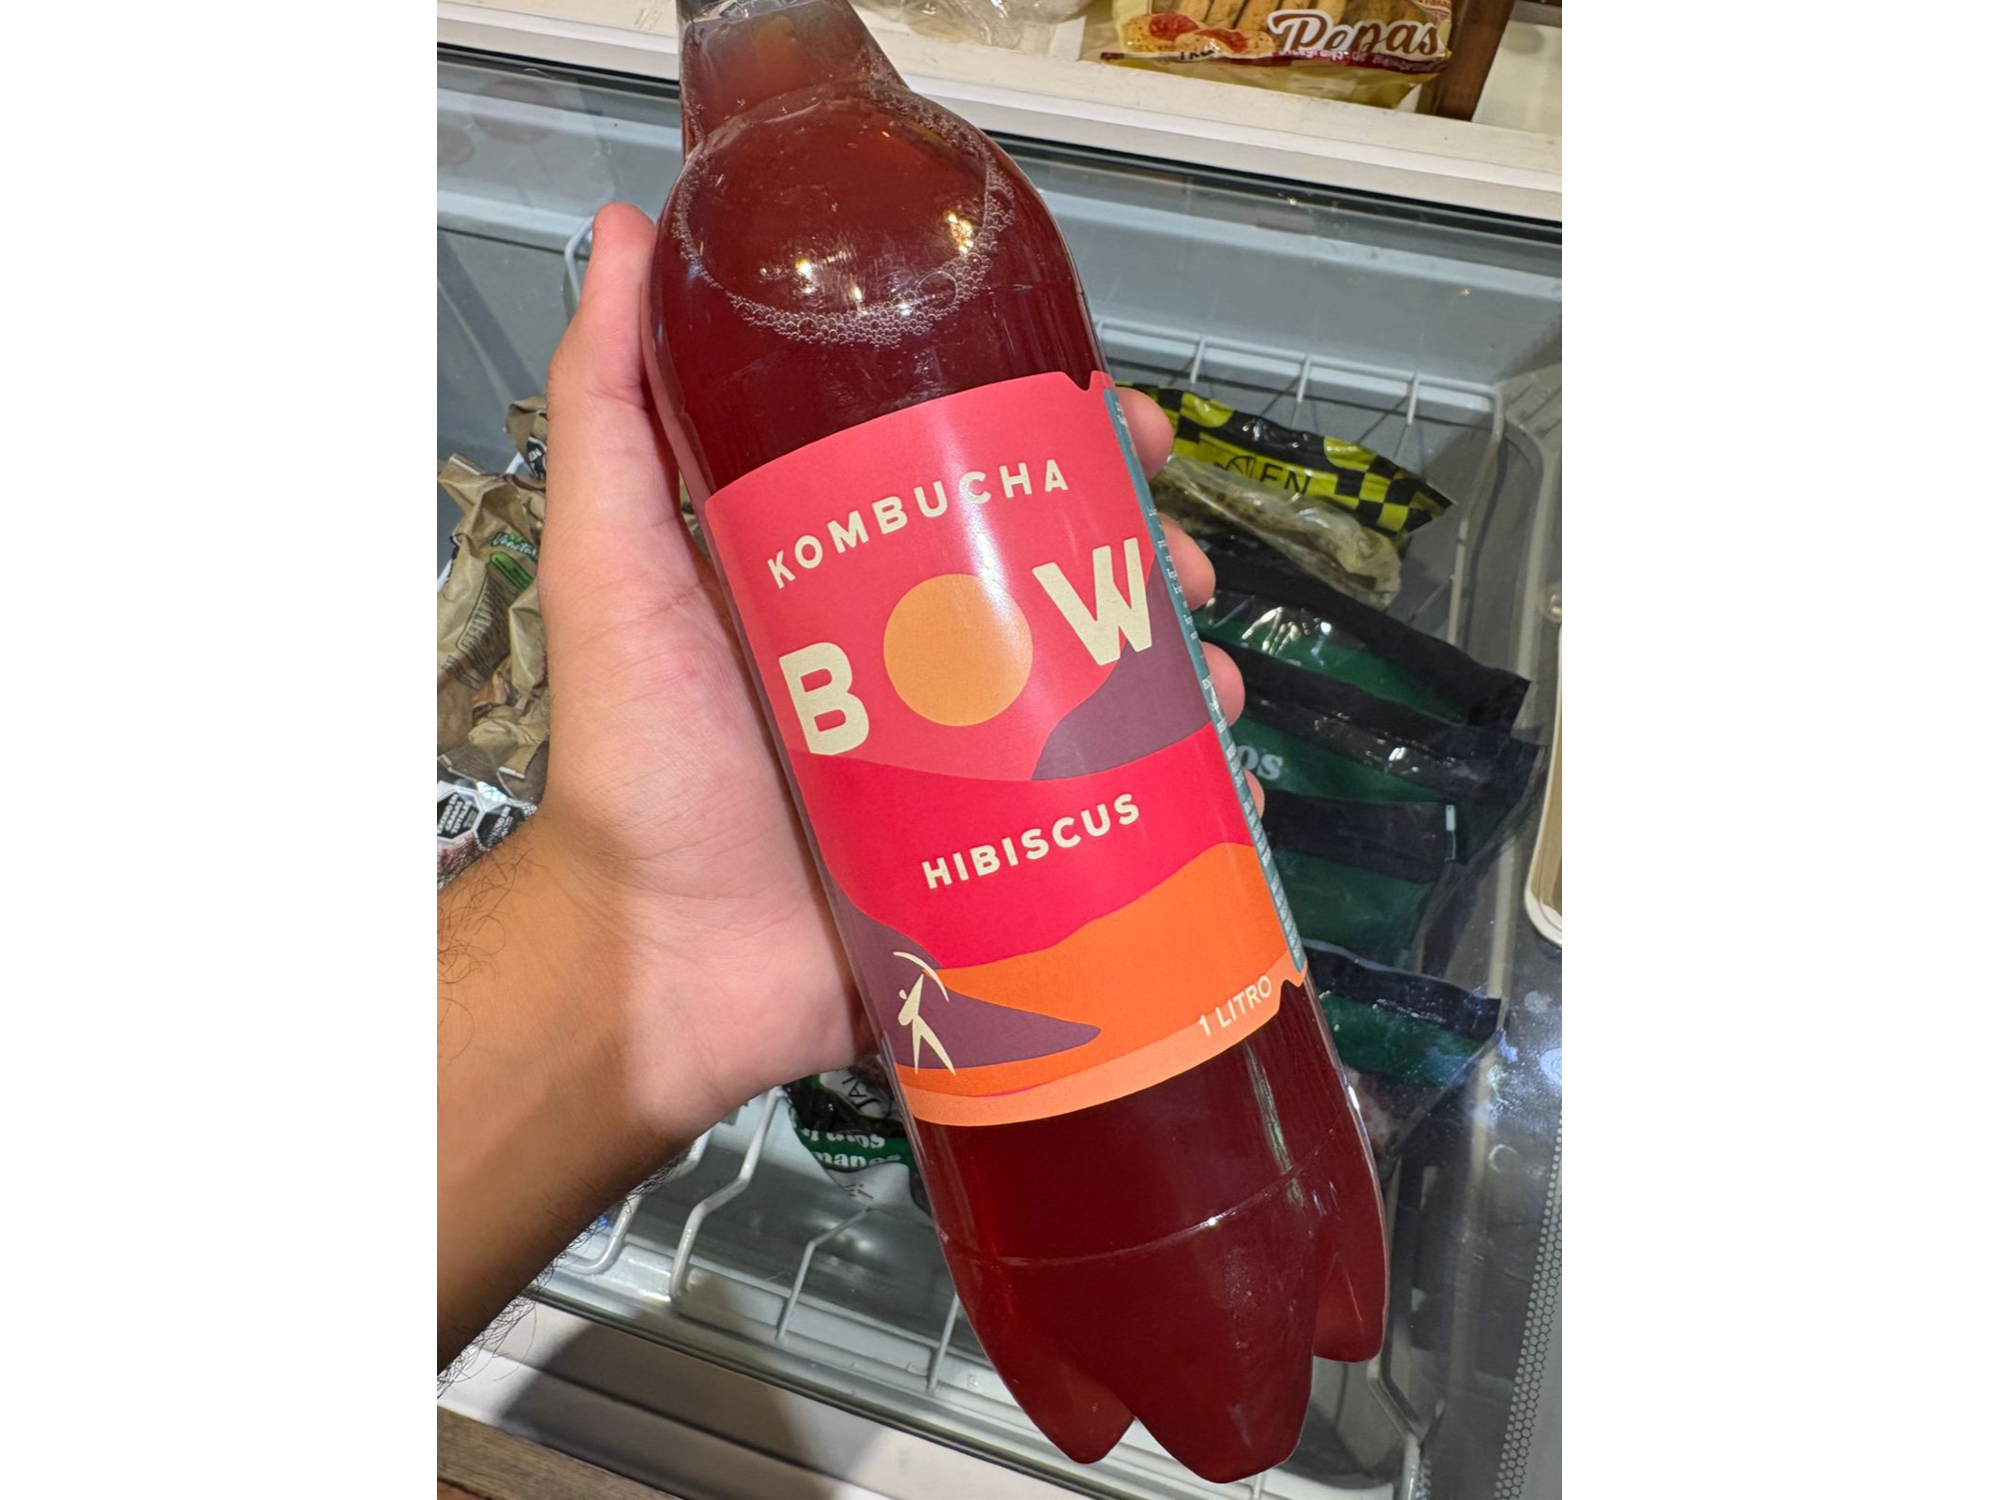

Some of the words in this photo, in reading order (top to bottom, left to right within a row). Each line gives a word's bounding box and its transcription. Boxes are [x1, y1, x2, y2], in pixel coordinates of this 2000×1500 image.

[1270, 12, 1441, 58] Pepas
[767, 459, 1069, 589] KOMBUCHA
[1236, 745, 1283, 780] os
[921, 793, 1140, 890] HIBISCUS
[1198, 1014, 1211, 1036] 1
[1215, 975, 1272, 1028] LITRO
